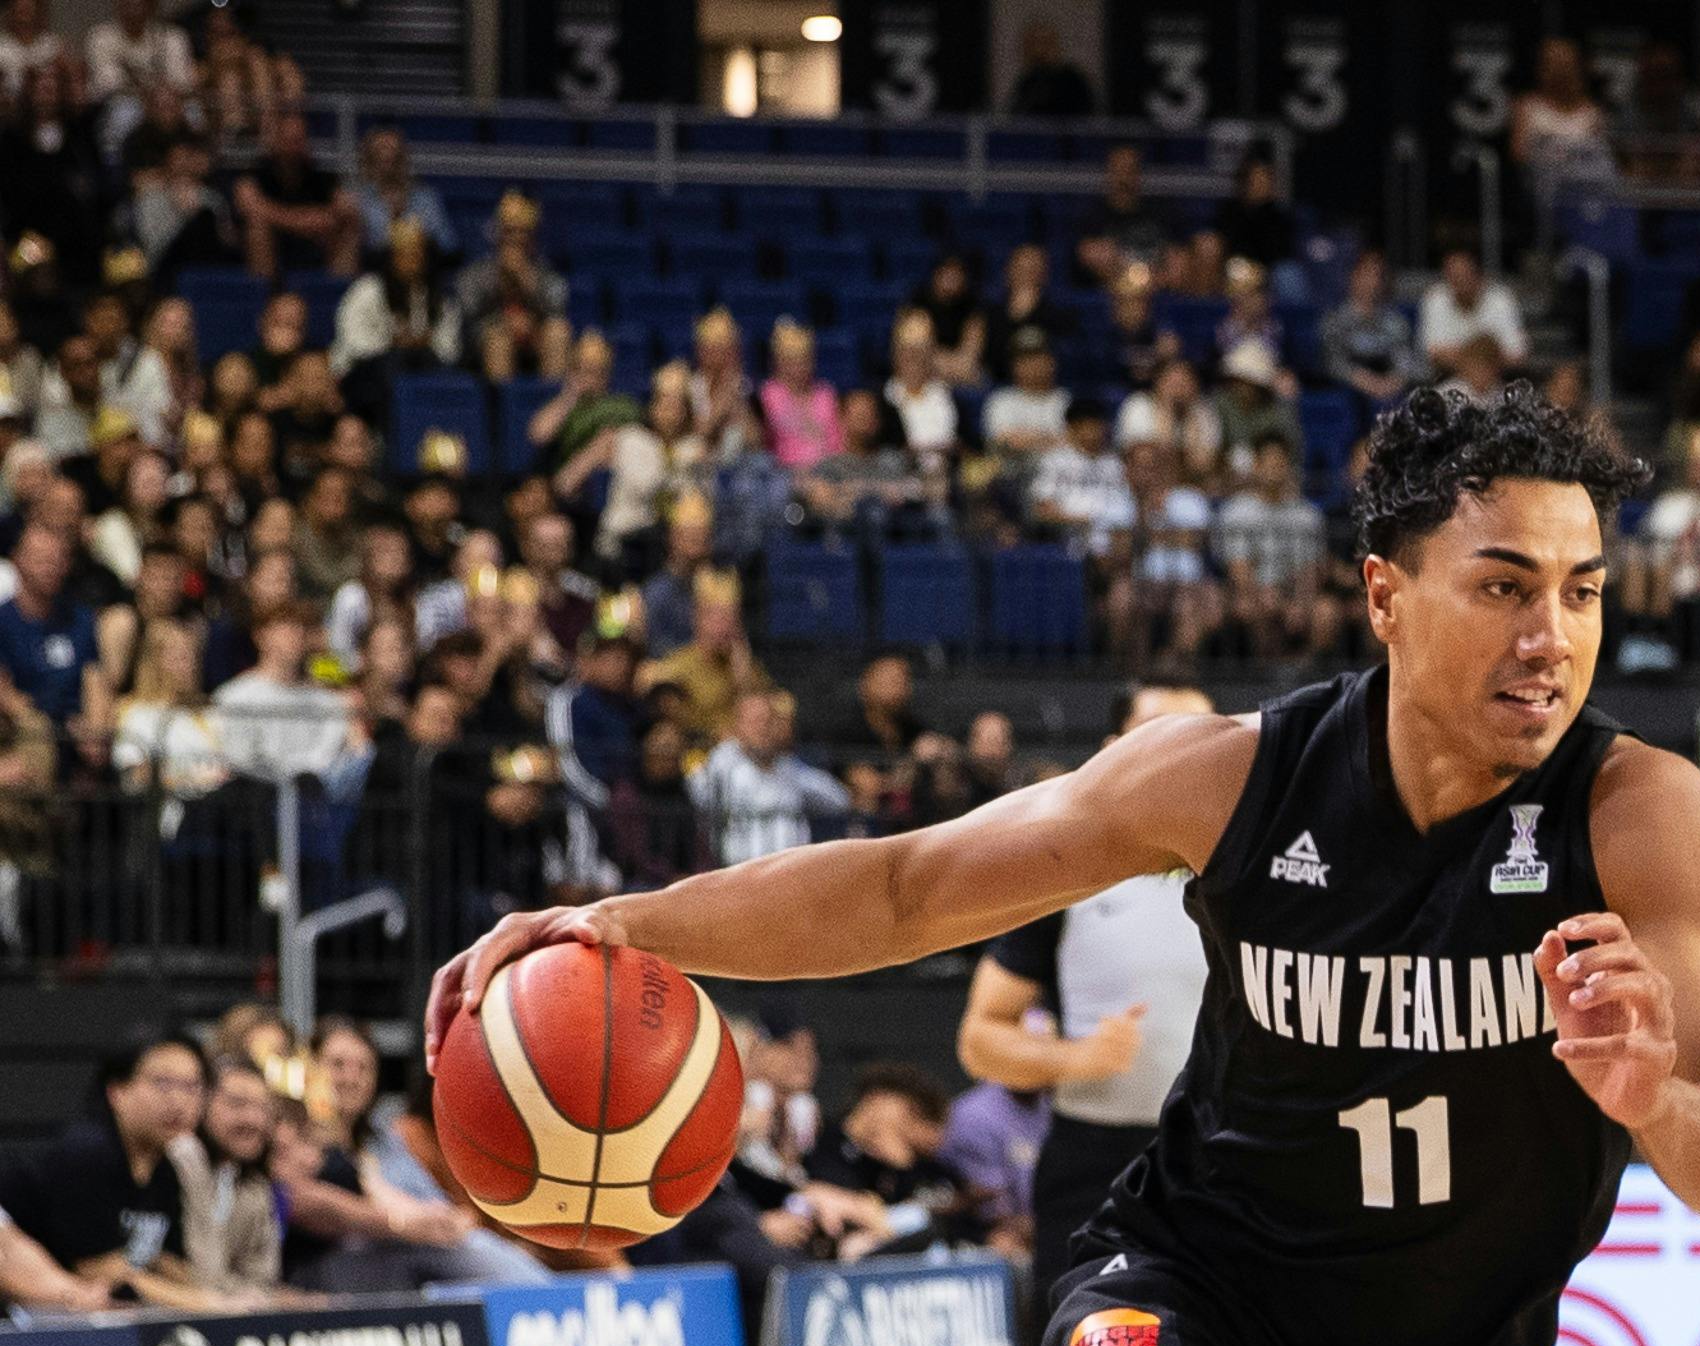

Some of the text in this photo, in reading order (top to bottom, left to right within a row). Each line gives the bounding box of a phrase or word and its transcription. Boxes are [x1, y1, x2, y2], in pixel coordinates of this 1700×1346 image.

[1146, 43, 1207, 129] 3
[1285, 45, 1346, 129] 3
[1269, 855, 1331, 888] PEAK
[1240, 941, 1557, 1052] NEW ZEALAN
[1338, 1096, 1451, 1208] 11
